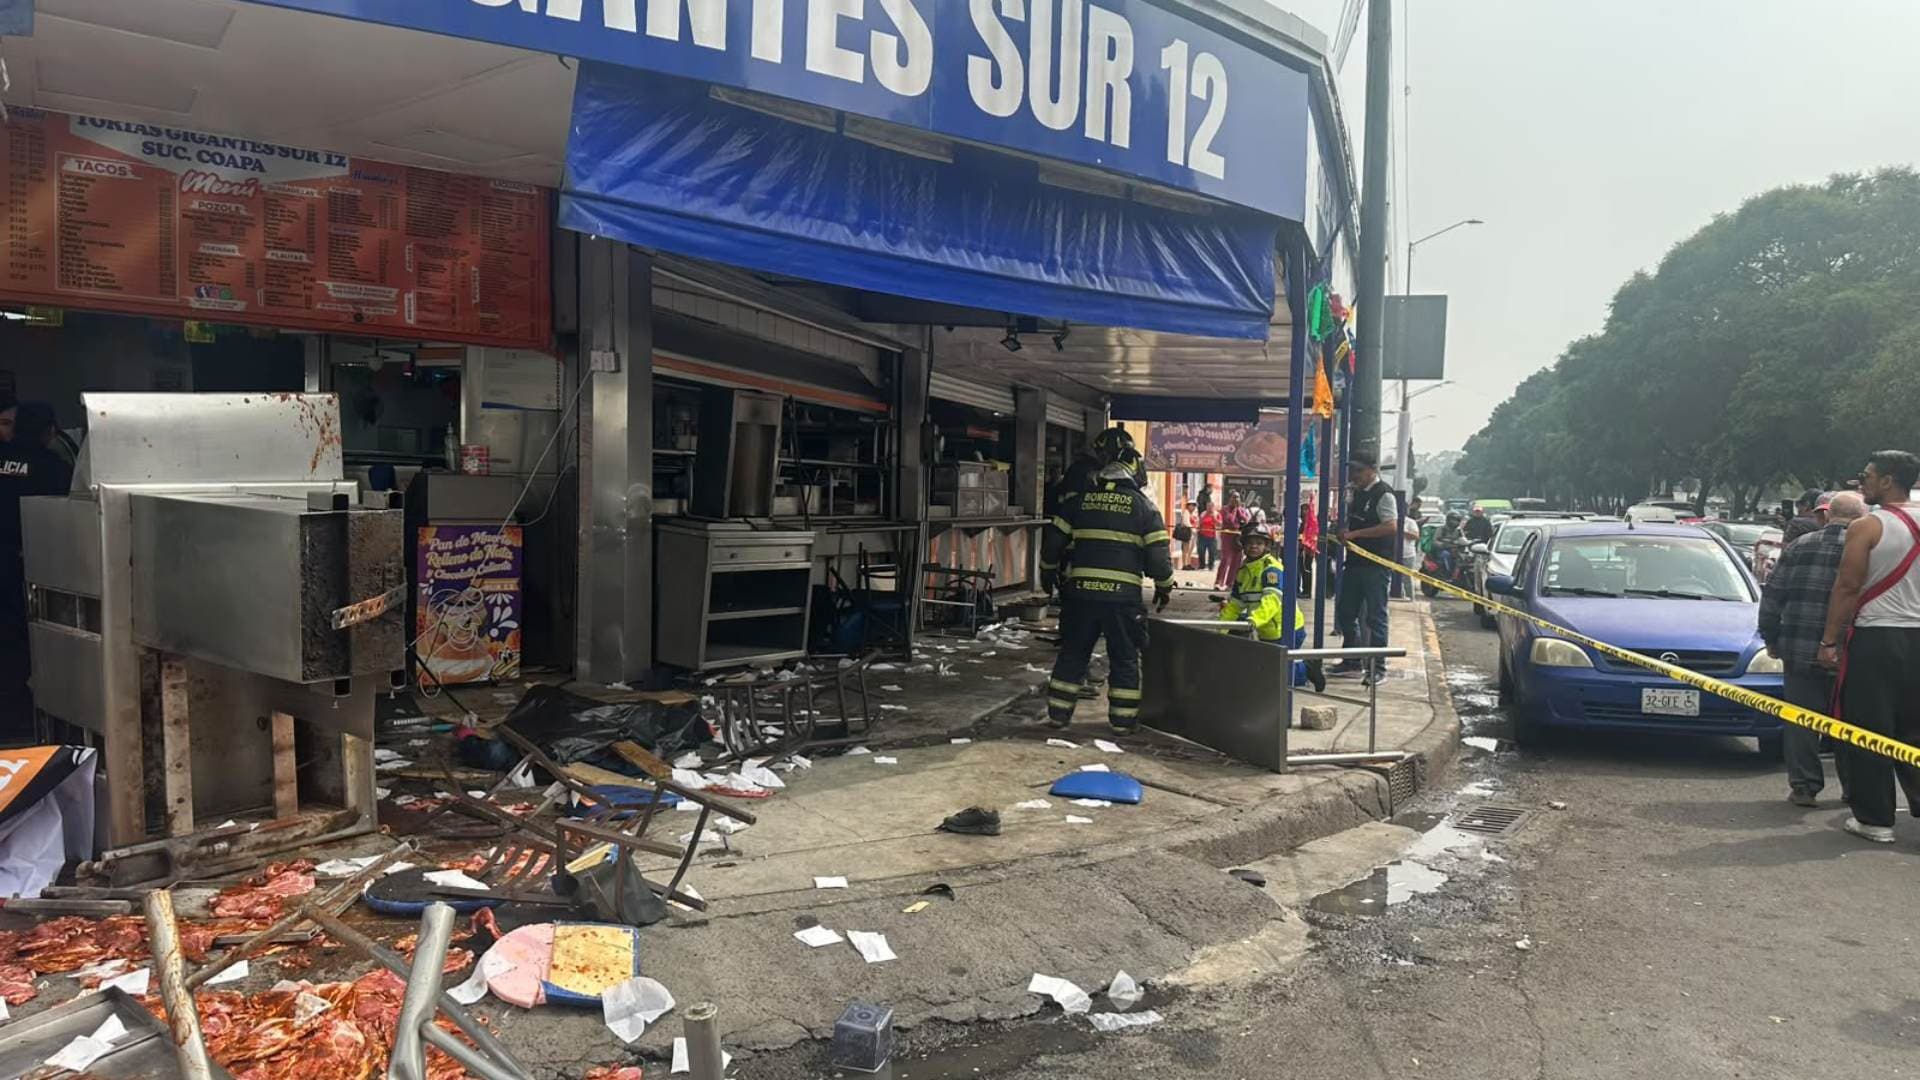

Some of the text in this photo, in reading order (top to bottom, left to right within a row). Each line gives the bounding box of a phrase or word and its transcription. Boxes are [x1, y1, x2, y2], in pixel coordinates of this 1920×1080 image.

[967, 0, 1134, 149] SUR
[1161, 38, 1228, 181] 12
[141, 141, 266, 174] SUC. COAPA
[76, 160, 128, 177] TACOS
[181, 171, 259, 198] Menú
[198, 201, 242, 213] POZOLE
[1084, 492, 1133, 505] BOMBEROS
[428, 537, 453, 551] Pan
[454, 535, 470, 549] de
